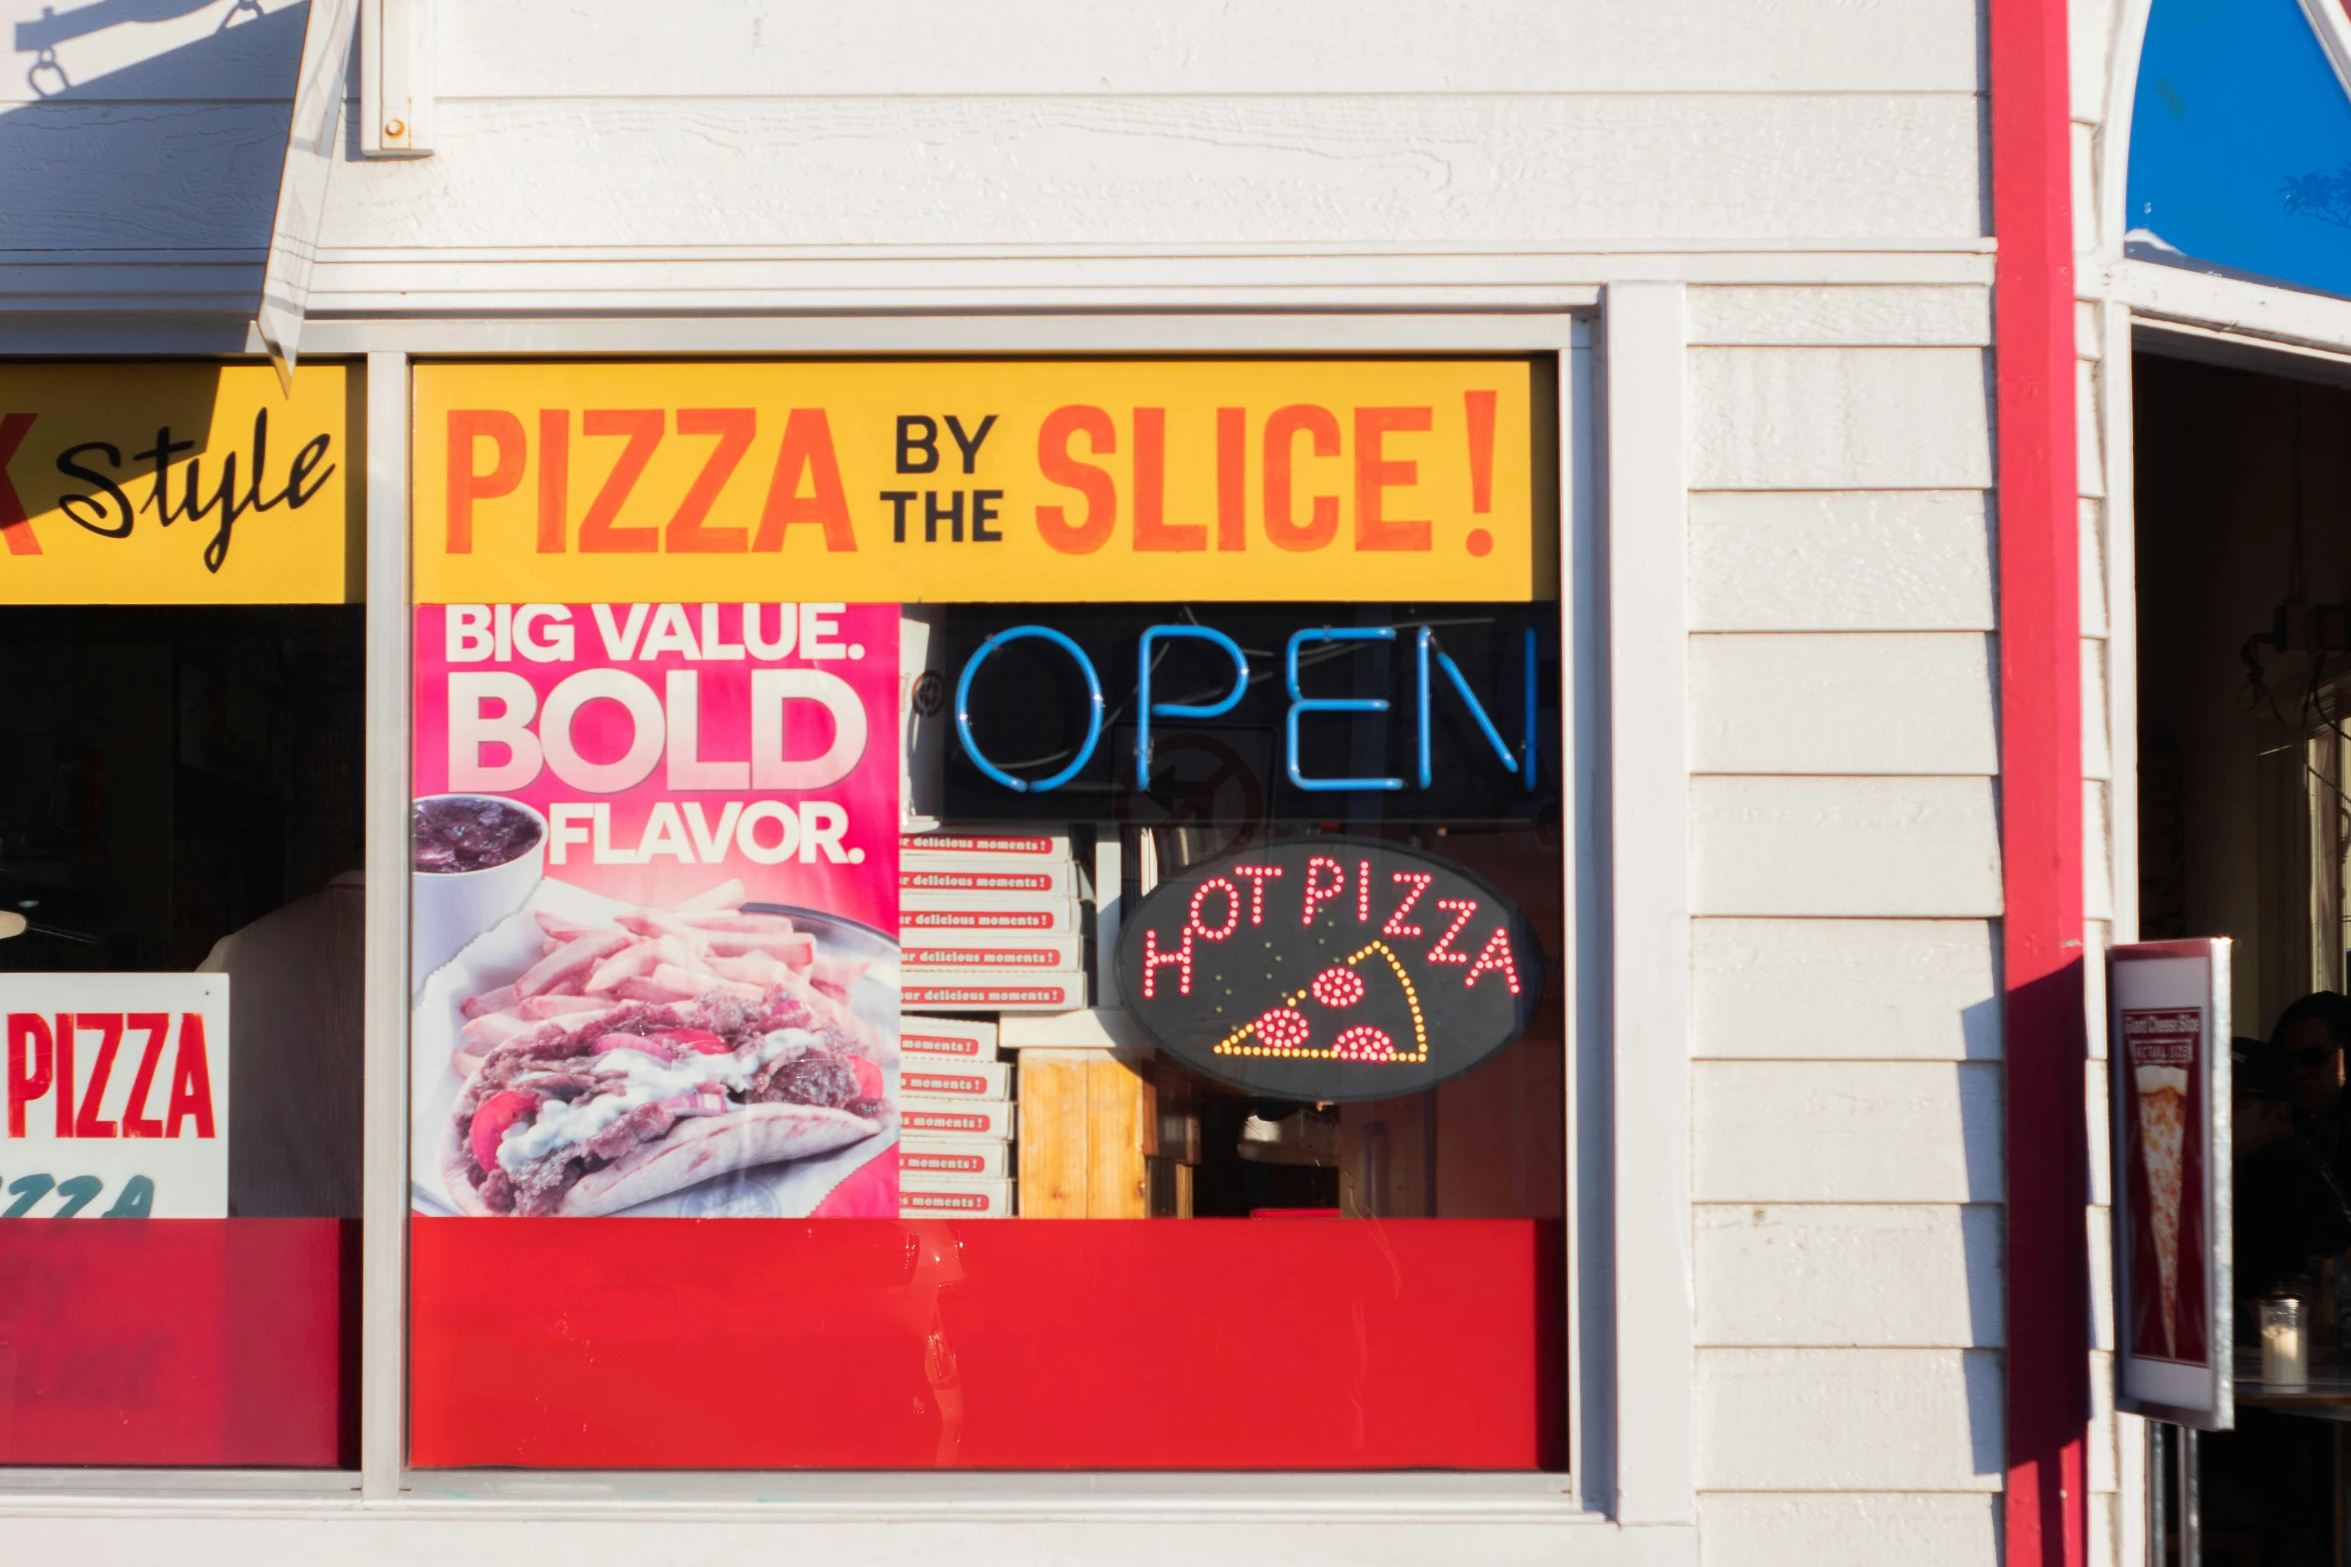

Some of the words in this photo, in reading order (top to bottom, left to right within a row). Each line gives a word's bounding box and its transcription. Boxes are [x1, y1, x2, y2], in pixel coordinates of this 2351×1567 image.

[895, 414, 999, 475] BY
[56, 406, 336, 574] Style
[445, 407, 858, 554] PIZZA
[880, 489, 1004, 543] THE
[445, 603, 575, 662] BIG
[590, 602, 866, 661] VALUE.
[448, 667, 868, 794] BOLD
[955, 624, 1537, 792] OPEN
[549, 801, 866, 865] FLAVOR.
[913, 837, 973, 849] delicious
[913, 875, 973, 887] delicious
[915, 914, 975, 926] delicious
[1143, 864, 1283, 999] HOT
[1302, 856, 1522, 994] PIZZA
[920, 951, 980, 963] delicious
[924, 989, 985, 1001] delicious
[7, 1012, 216, 1139] PIZZA
